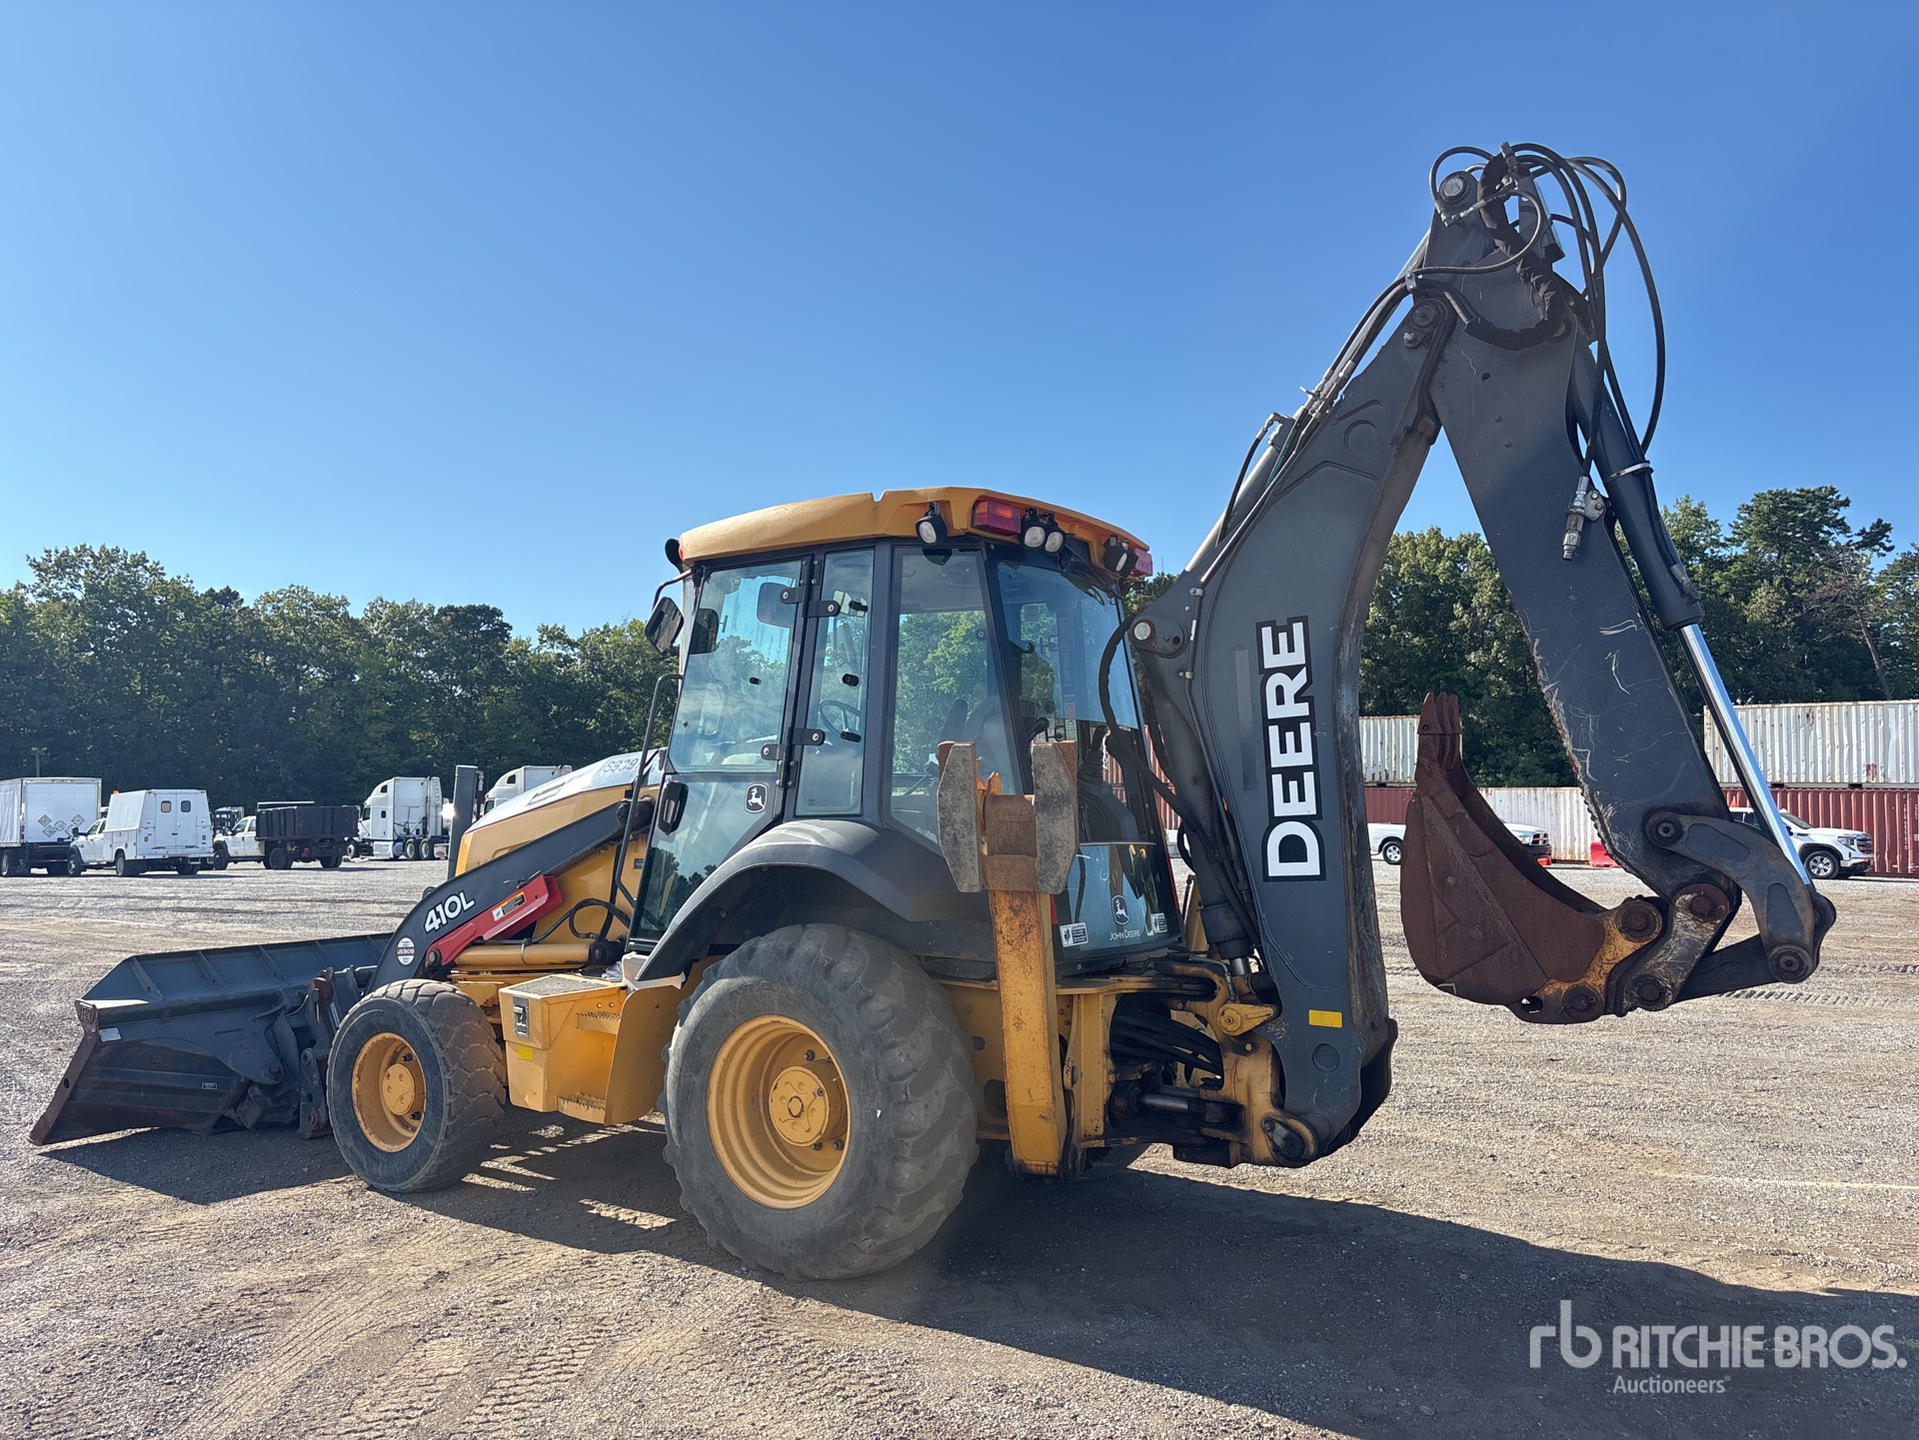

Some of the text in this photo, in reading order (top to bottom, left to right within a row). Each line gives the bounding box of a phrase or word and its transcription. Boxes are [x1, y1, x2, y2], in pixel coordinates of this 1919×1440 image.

[1261, 622, 1321, 877] DEERE
[424, 891, 475, 934] 410L
[1109, 929, 1141, 941] JOHN DEERE
